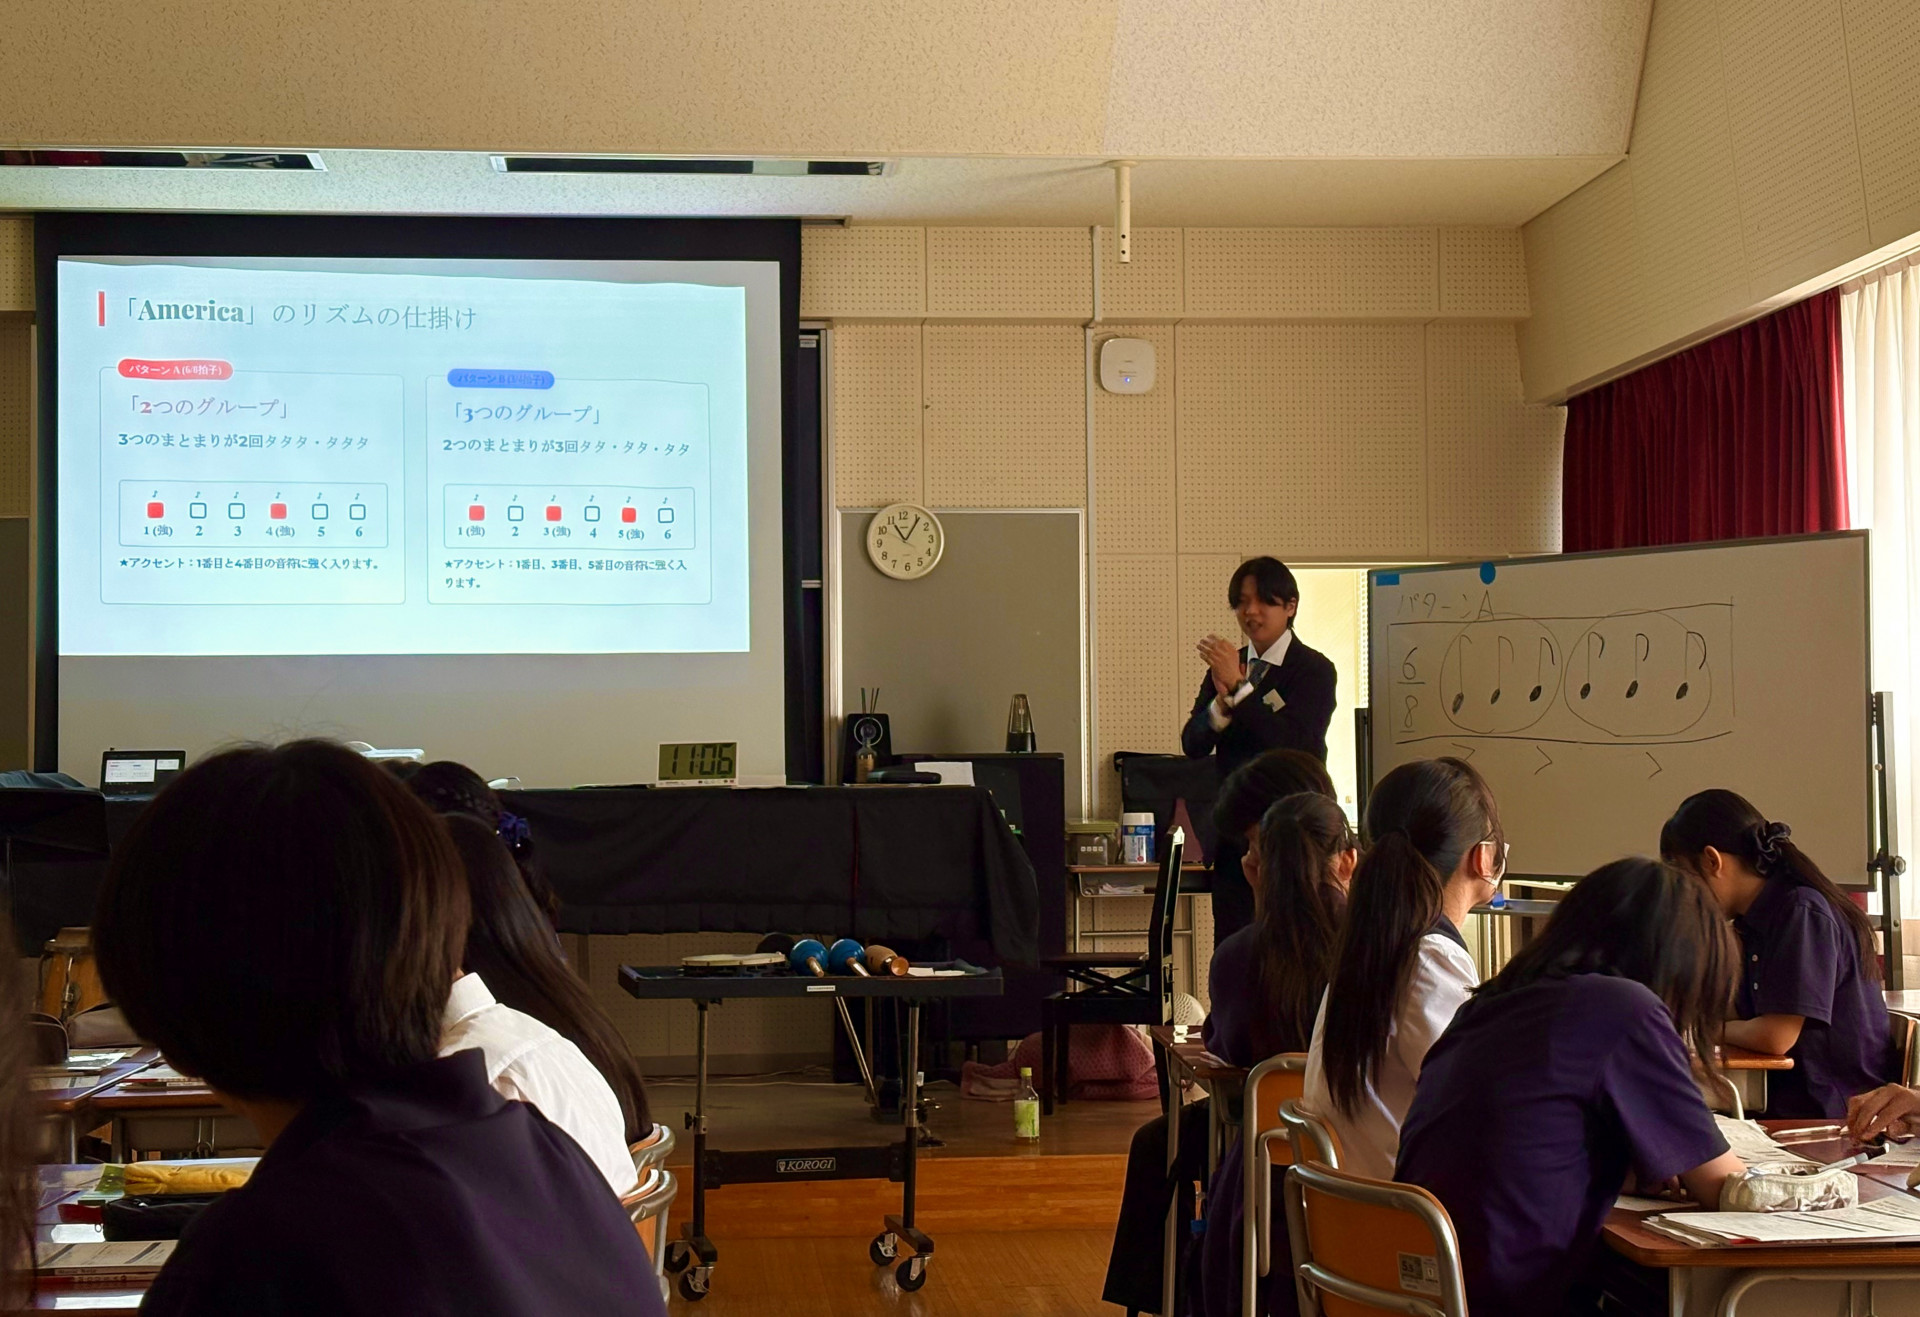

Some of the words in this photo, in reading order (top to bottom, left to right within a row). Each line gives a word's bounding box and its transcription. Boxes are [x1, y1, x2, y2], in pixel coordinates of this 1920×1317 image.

[131, 395, 287, 419] 「2つのグループ」
[455, 402, 600, 425] 「3つのグループ」
[898, 511, 908, 520] 12
[887, 516, 895, 525] 11
[878, 526, 887, 535] 10
[923, 522, 929, 531] 2
[195, 526, 203, 537] 2
[234, 526, 242, 537] 3
[317, 526, 325, 537] 5
[355, 527, 363, 538] 6
[511, 526, 519, 537] 2
[589, 527, 597, 539] 4
[664, 529, 672, 540] 6
[928, 534, 934, 543] 3
[876, 539, 883, 548] 9
[881, 551, 888, 560] 8
[926, 548, 931, 557] 4
[891, 560, 897, 568] 7
[904, 563, 911, 571] 6
[917, 558, 923, 567] 5
[1402, 646, 1418, 680] 6
[1404, 695, 1419, 728] 8
[786, 1159, 833, 1171] KOROGI
